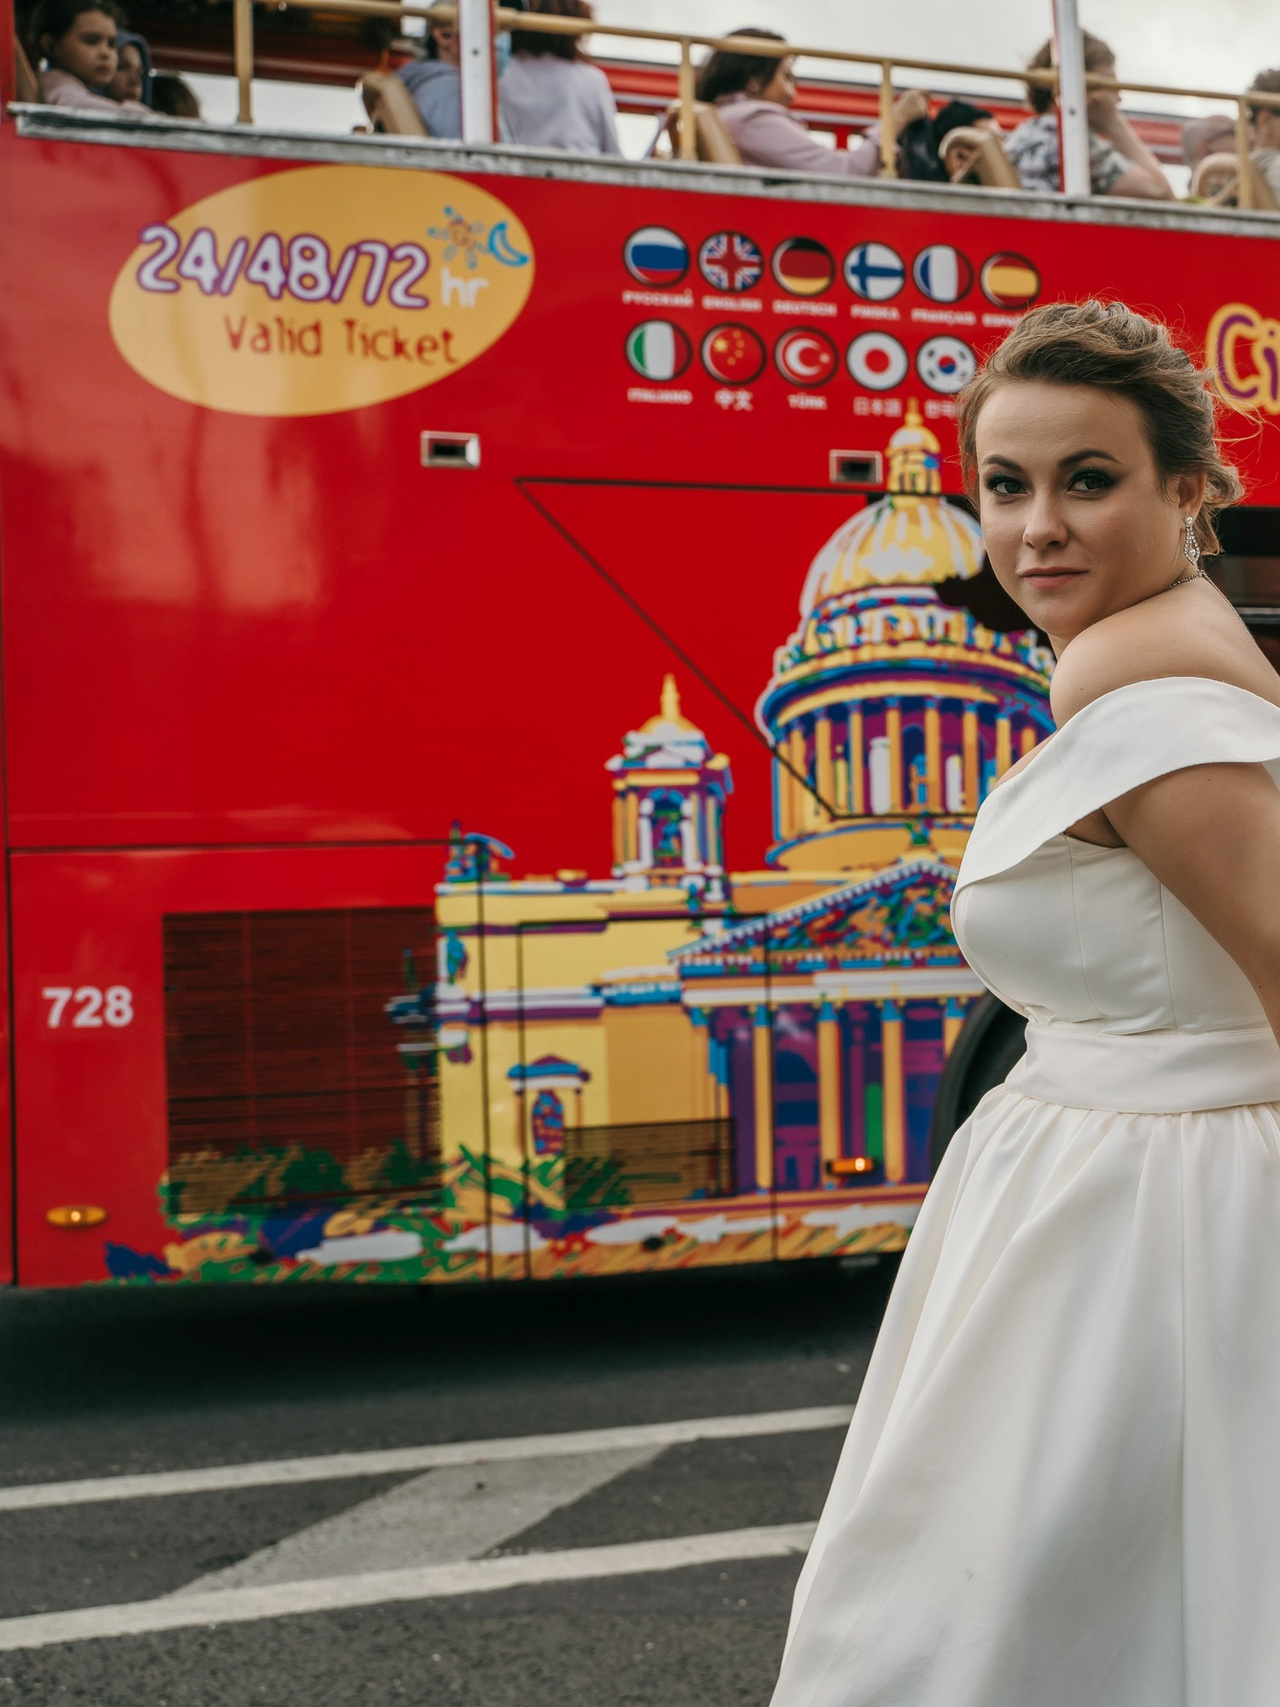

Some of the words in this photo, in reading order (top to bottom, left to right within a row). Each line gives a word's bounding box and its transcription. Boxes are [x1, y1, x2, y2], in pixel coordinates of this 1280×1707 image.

[137, 224, 430, 309] 24/48/72
[441, 267, 489, 307] hr
[622, 288, 693, 308] РУССКИЙ
[702, 295, 762, 312] ENGLISH
[773, 299, 837, 317] DEUTSCH
[224, 315, 323, 357] Valid
[342, 318, 459, 366] Ticket
[627, 387, 693, 404] ITALIANO
[714, 388, 752, 411] 中文
[42, 985, 134, 1029] 728
